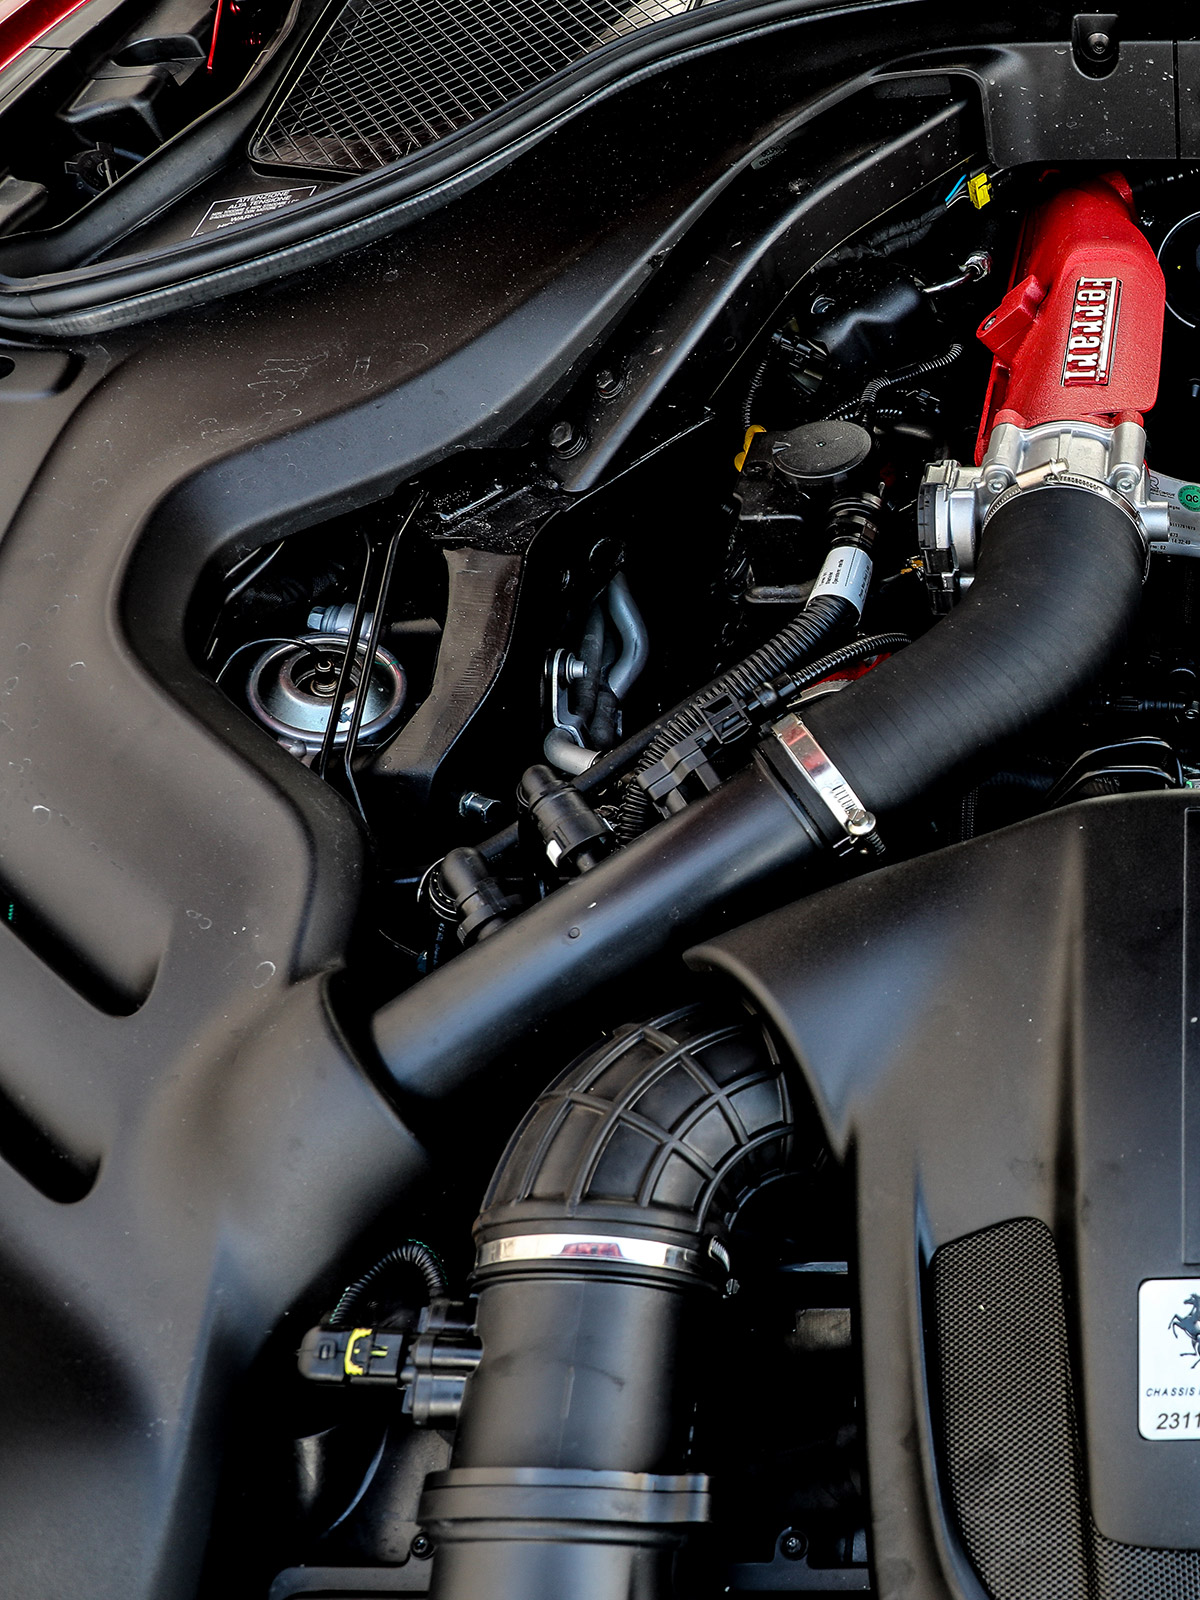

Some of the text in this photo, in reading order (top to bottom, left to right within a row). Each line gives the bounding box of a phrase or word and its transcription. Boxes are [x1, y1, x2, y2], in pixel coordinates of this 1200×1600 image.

[228, 201, 247, 210] ALTA
[250, 195, 292, 206] TENSIONE
[236, 190, 291, 203] ATTENZIONE
[1065, 276, 1118, 382] Ferrari
[1185, 494, 1199, 503] QC
[1146, 1386, 1196, 1398] CHASSIS
